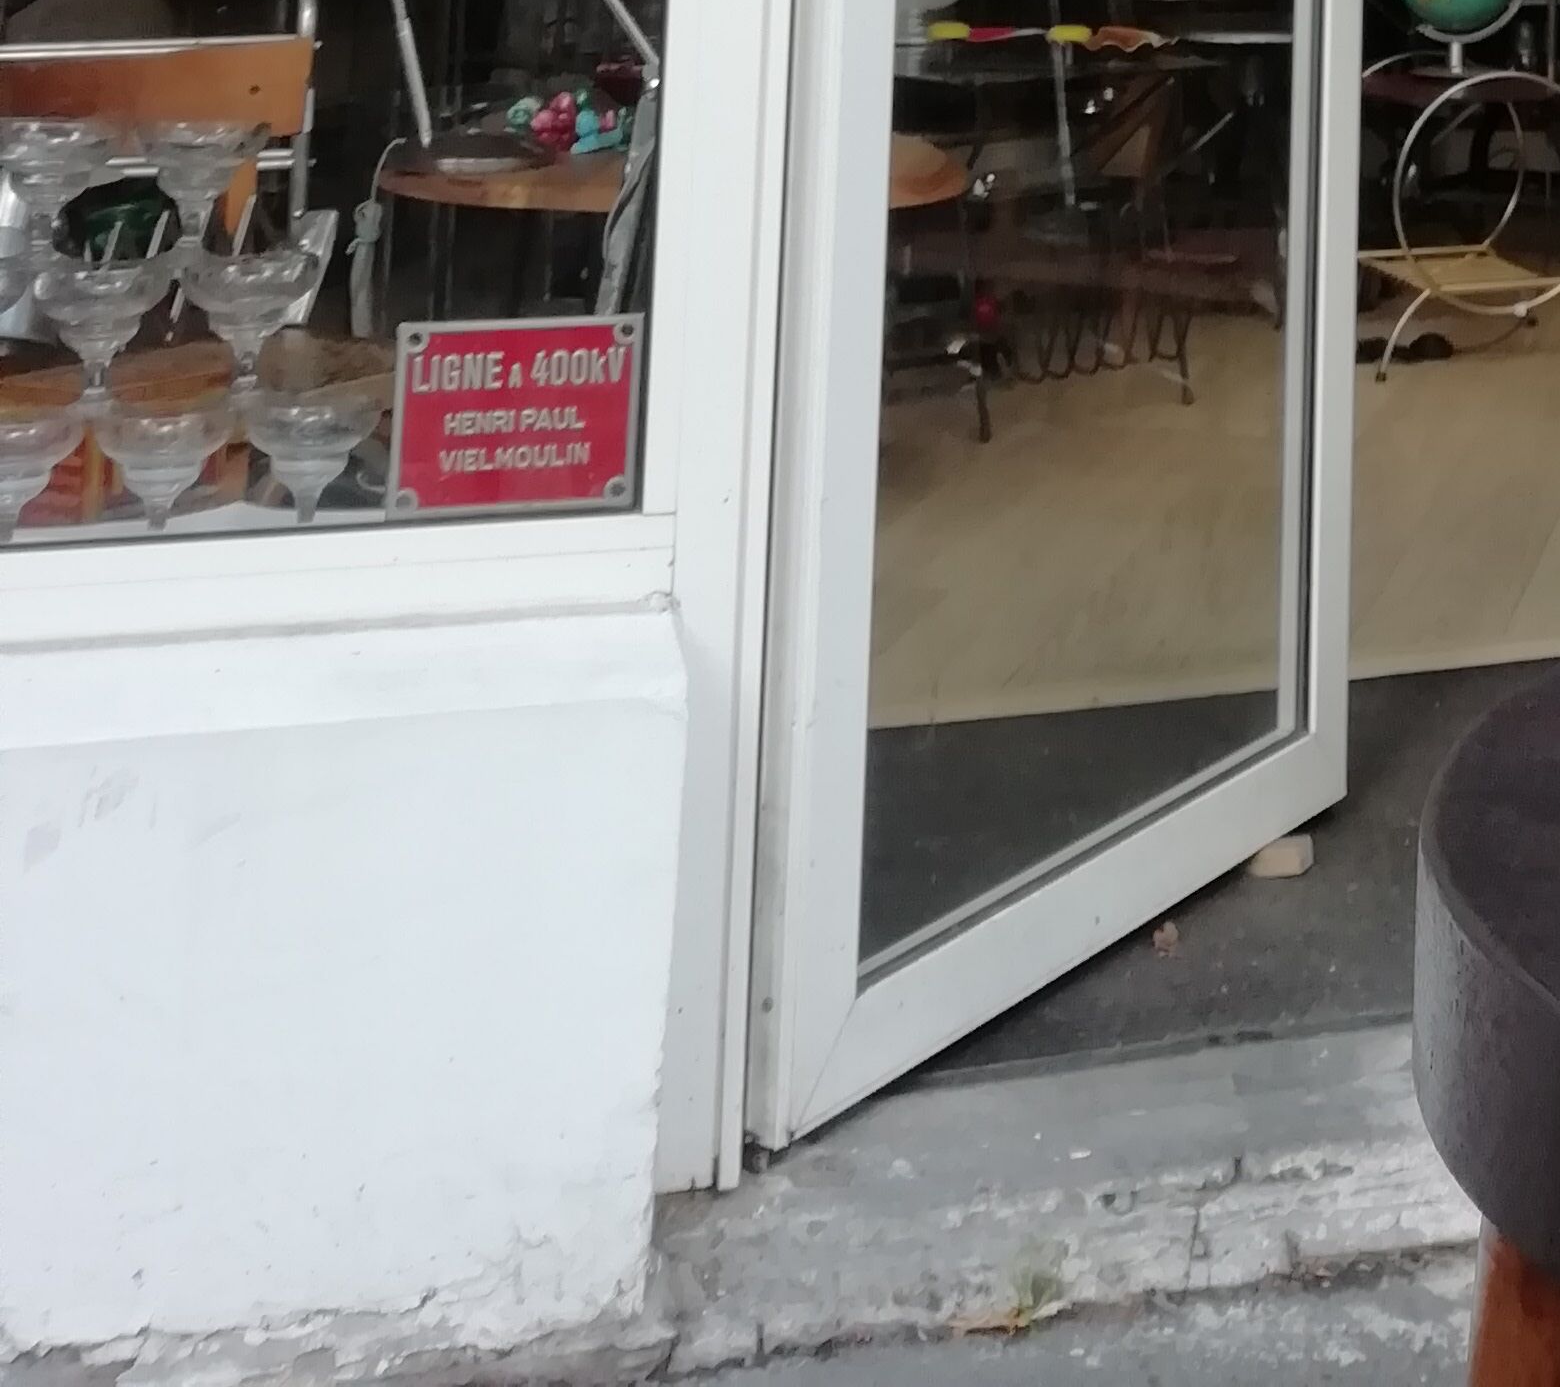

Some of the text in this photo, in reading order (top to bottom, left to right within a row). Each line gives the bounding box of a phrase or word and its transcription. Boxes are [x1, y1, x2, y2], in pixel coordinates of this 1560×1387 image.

[411, 351, 506, 394] LIGNE
[530, 345, 629, 387] 400kV
[443, 405, 587, 436] HENRI PAUL
[437, 440, 592, 474] VIELMOULIN
